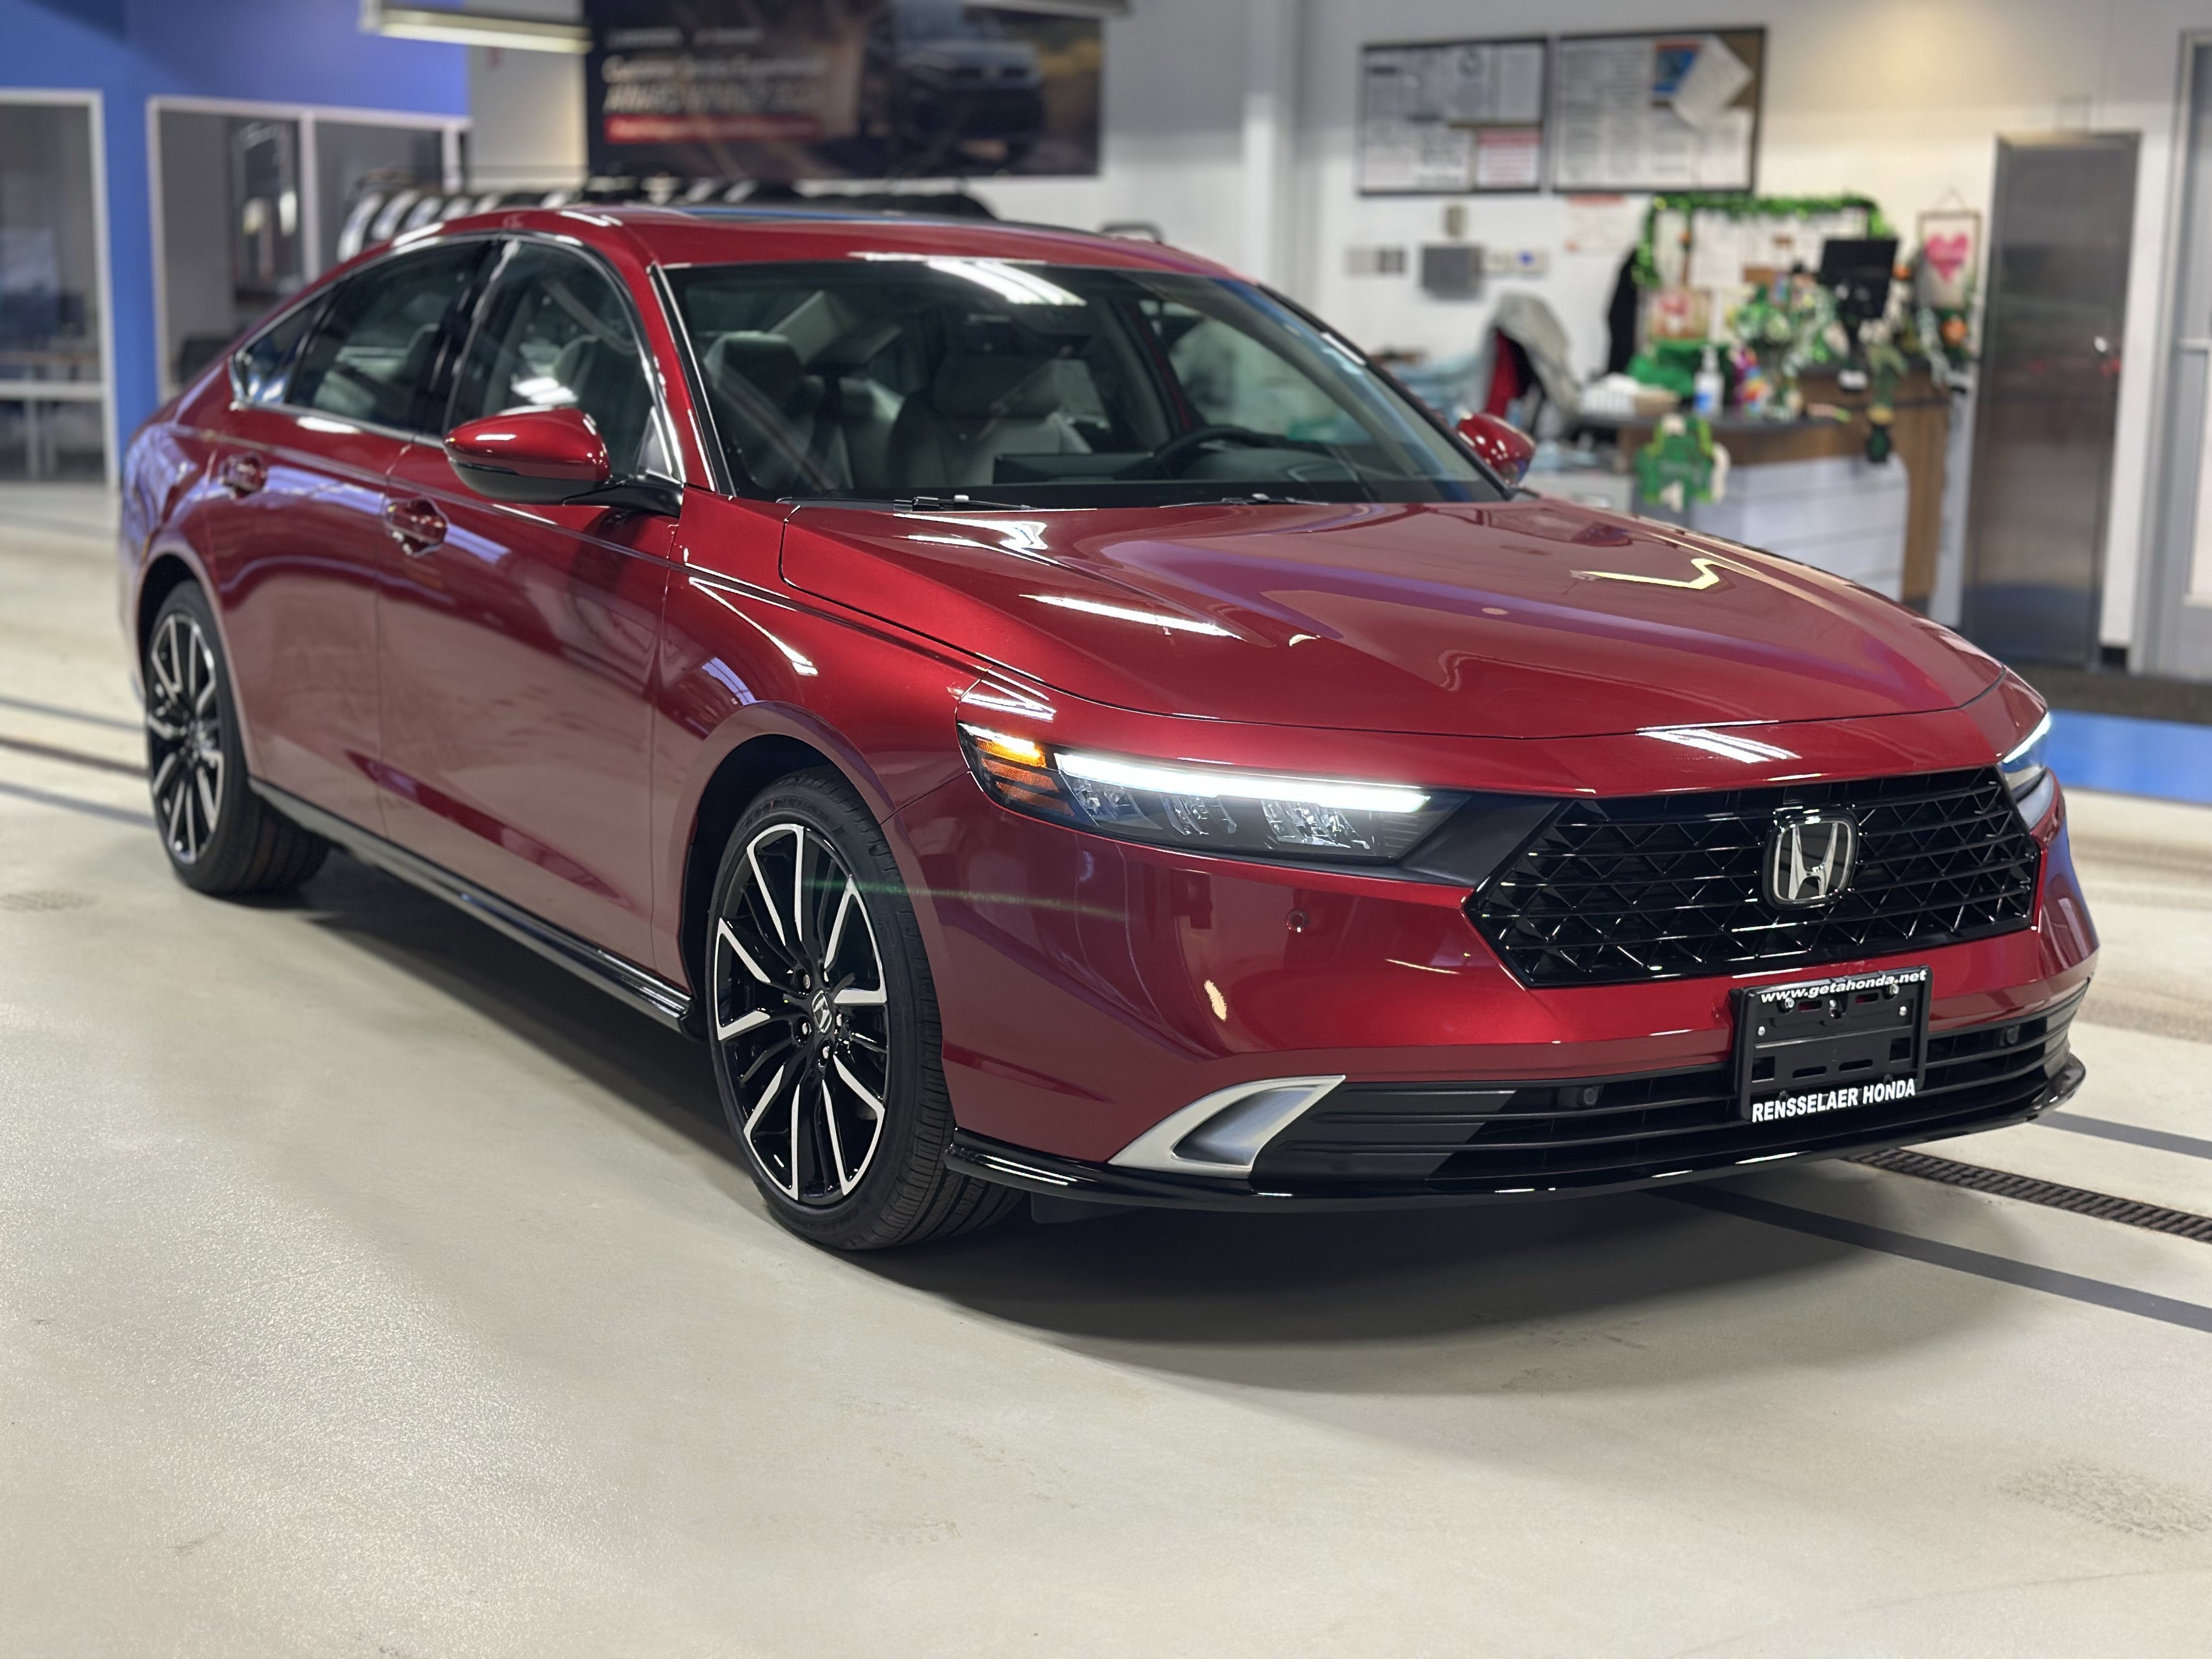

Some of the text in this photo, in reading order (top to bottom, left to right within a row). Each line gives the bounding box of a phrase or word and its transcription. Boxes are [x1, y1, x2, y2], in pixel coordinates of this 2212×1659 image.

[1760, 969, 1927, 1003] www.getahonda.net
[1752, 1078, 1916, 1122] RENSSELAER HONDA
